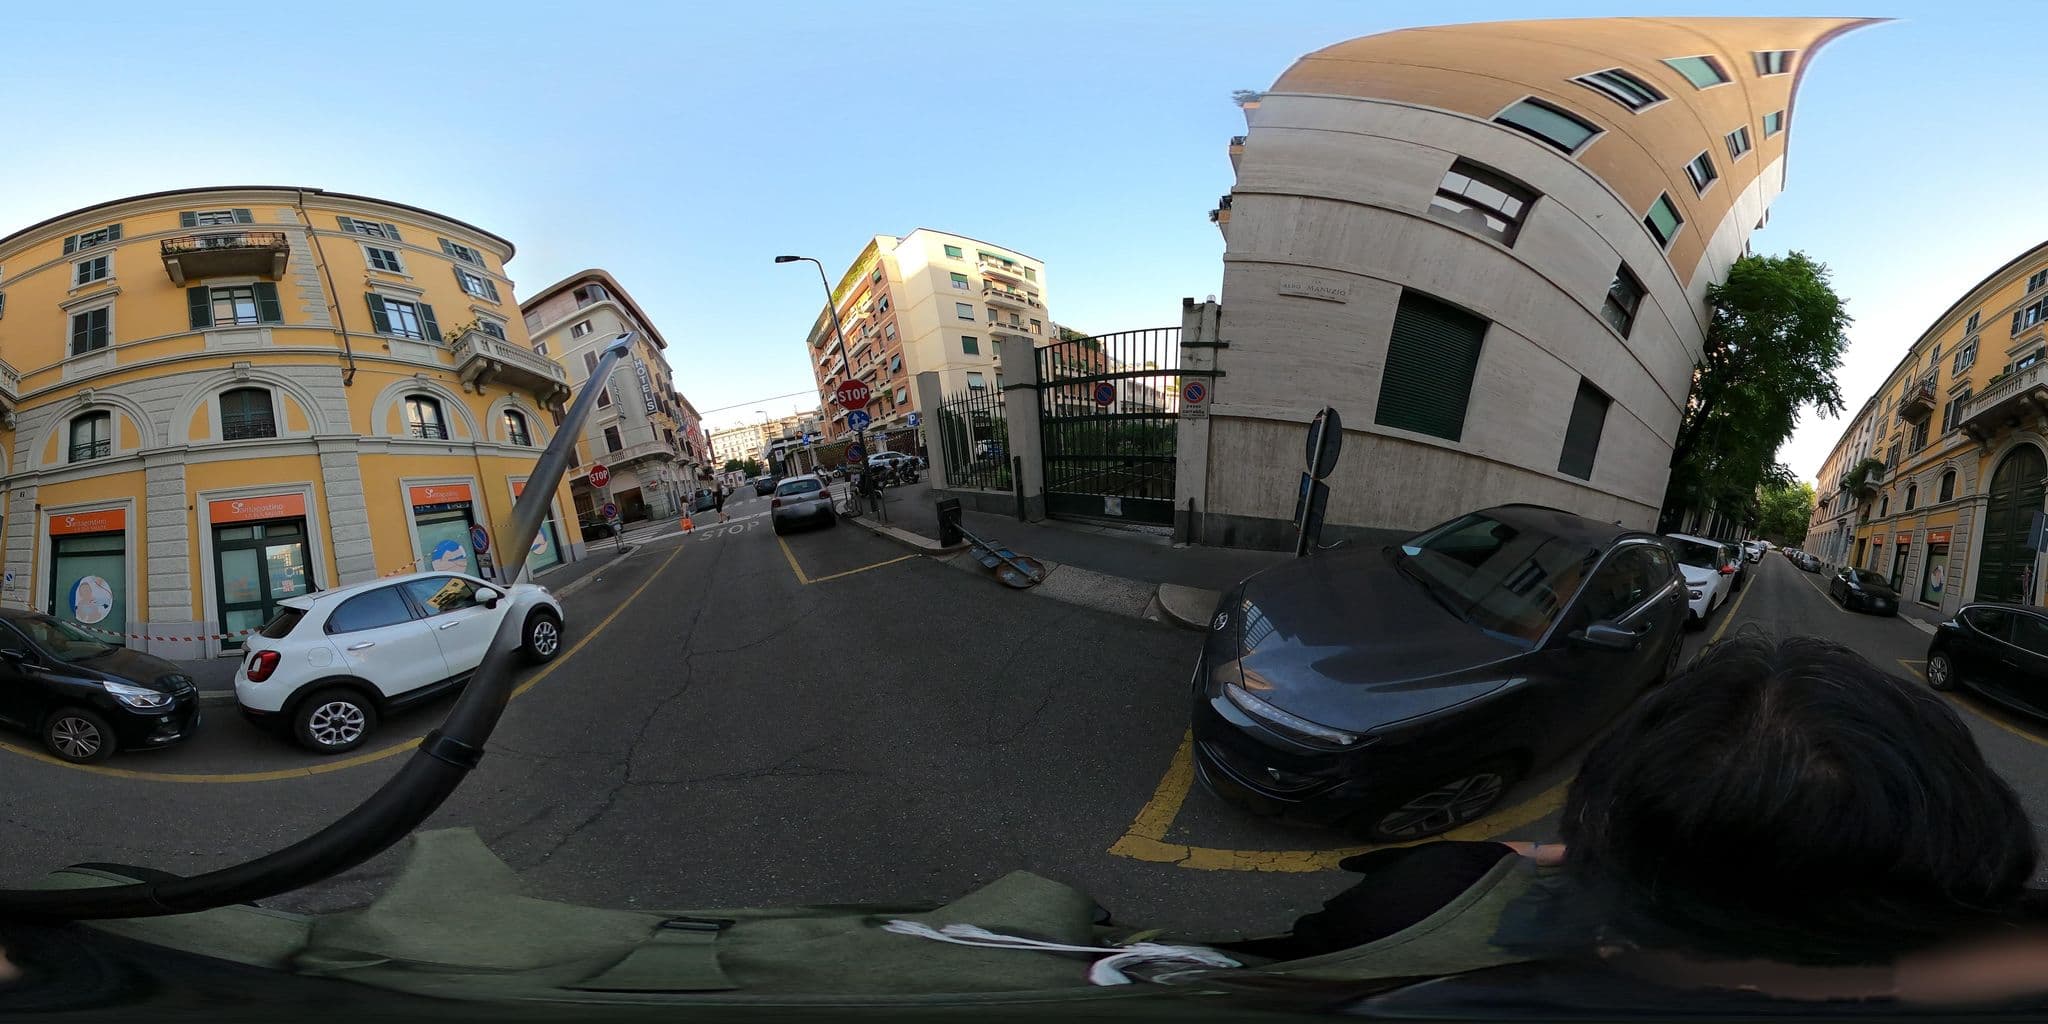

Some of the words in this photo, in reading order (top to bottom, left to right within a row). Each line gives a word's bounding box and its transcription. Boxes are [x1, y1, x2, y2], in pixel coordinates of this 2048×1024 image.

[633, 359, 656, 411] HOTELS
[838, 387, 868, 402] STOP
[590, 470, 608, 482] STOP
[699, 521, 760, 541] STOP
